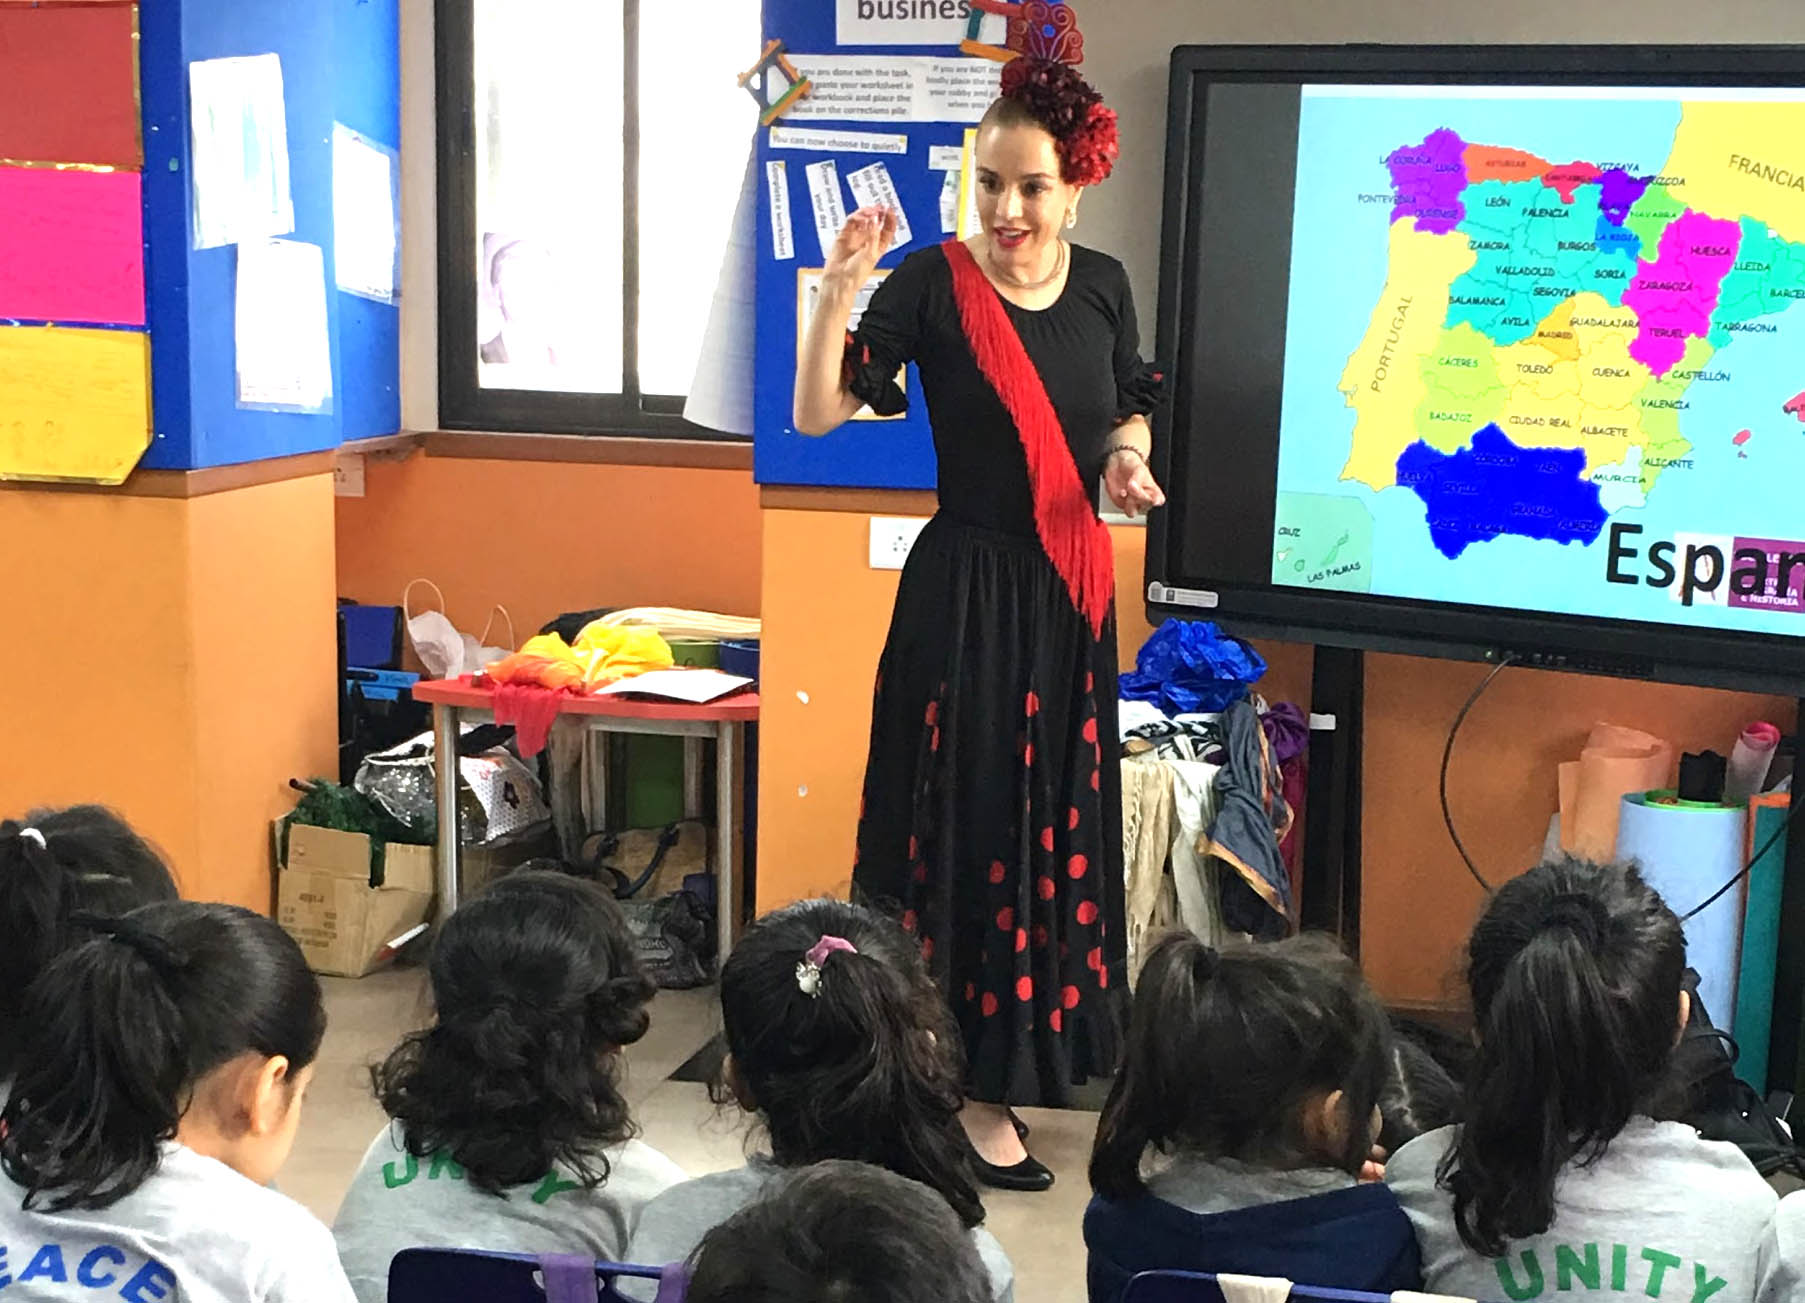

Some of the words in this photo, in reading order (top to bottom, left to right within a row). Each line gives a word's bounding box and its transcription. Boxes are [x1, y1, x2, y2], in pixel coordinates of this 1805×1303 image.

[1434, 163, 1461, 172] LUGO
[1728, 153, 1805, 192] FRANCIA
[1485, 195, 1511, 208] LEÓN
[1521, 207, 1569, 218] PALENCIA
[1469, 240, 1510, 251] ZAMORA
[1557, 241, 1597, 251] BURGOS
[1690, 245, 1731, 257] HUESCA
[1495, 265, 1555, 277] VALLADOLID
[1734, 261, 1771, 273] LLEIDA
[1594, 269, 1626, 280] SORIA
[1639, 279, 1693, 292] ZARAGOZA
[1532, 287, 1576, 298] SEGOVIA
[1448, 295, 1506, 307] SALAMANCA
[1569, 316, 1641, 328] GUADALAJARA
[1714, 321, 1777, 333] TARRAGONA
[1538, 331, 1573, 340] MADRID
[1649, 327, 1684, 338] TERUEL
[1370, 295, 1413, 393] PORTUGAL
[1516, 362, 1554, 375] TOLEDO
[1591, 367, 1631, 378] CUENCA
[1671, 370, 1731, 382] CASTELLÓN
[1640, 398, 1690, 410] VALENCIA
[1429, 411, 1473, 423] BADAJOZ
[1509, 415, 1545, 426] CIUDAD
[1548, 417, 1572, 429] REAL
[1580, 426, 1629, 437] ALBACETE
[1643, 457, 1694, 470] ALICANTE
[1593, 473, 1647, 484] MURCIA
[1278, 526, 1301, 537] CRUZ
[1306, 571, 1325, 584] LAS
[1325, 561, 1361, 578] PALMAS
[1495, 1242, 1728, 1303] UNITY
